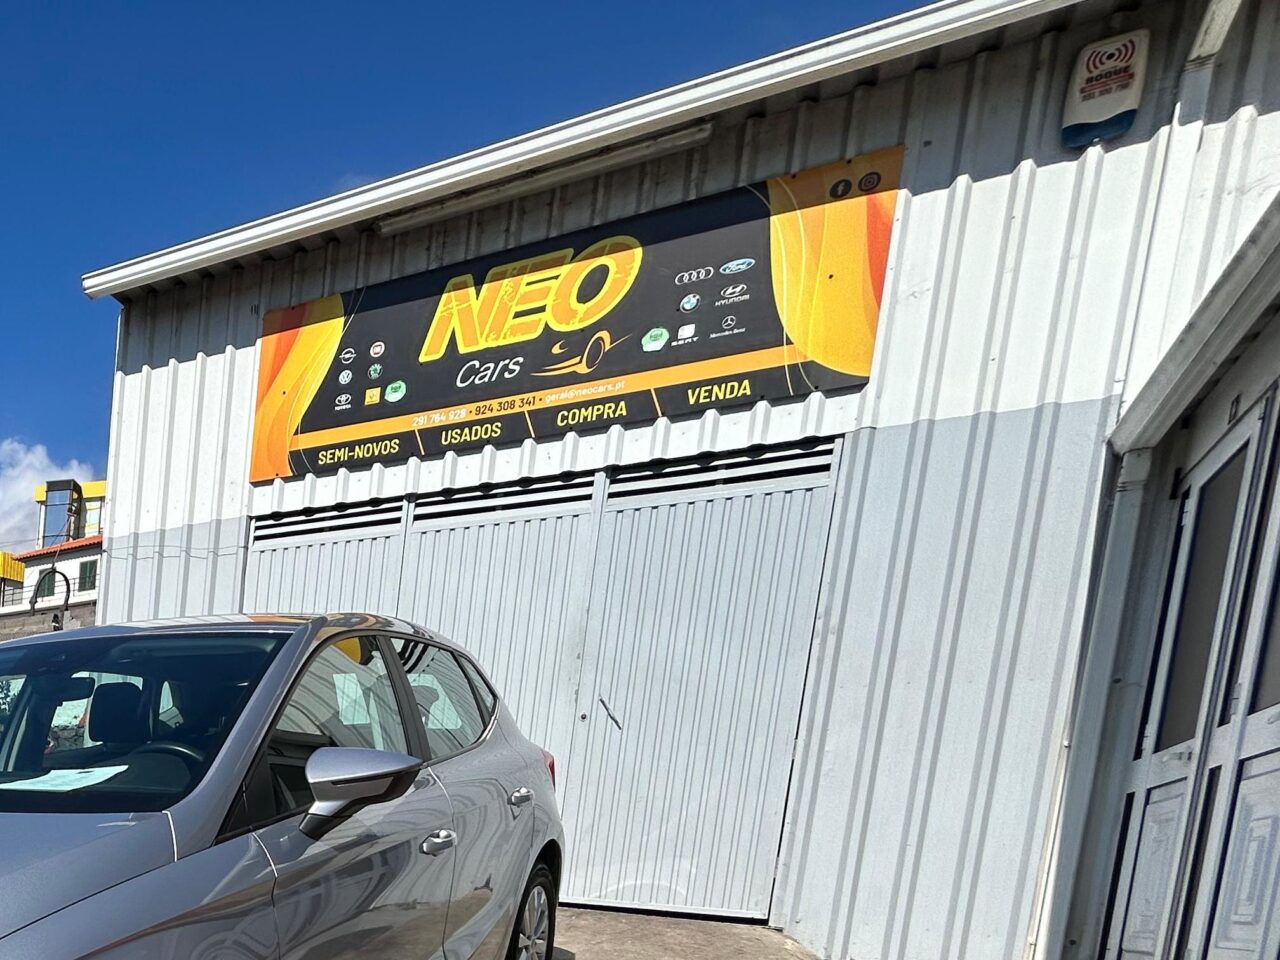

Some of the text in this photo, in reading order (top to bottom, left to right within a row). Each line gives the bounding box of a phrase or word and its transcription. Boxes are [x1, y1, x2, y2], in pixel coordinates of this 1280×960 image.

[418, 235, 643, 363] NEO
[412, 415, 427, 427] 291
[448, 408, 466, 422] 928
[474, 404, 494, 416] 924
[496, 400, 516, 412] 308
[518, 396, 536, 409] 341
[545, 380, 625, 404] geral@neocars.pt
[455, 356, 524, 388] Cars
[317, 379, 751, 465] SEMI-NOVOS USADOS COMPRA VENDA
